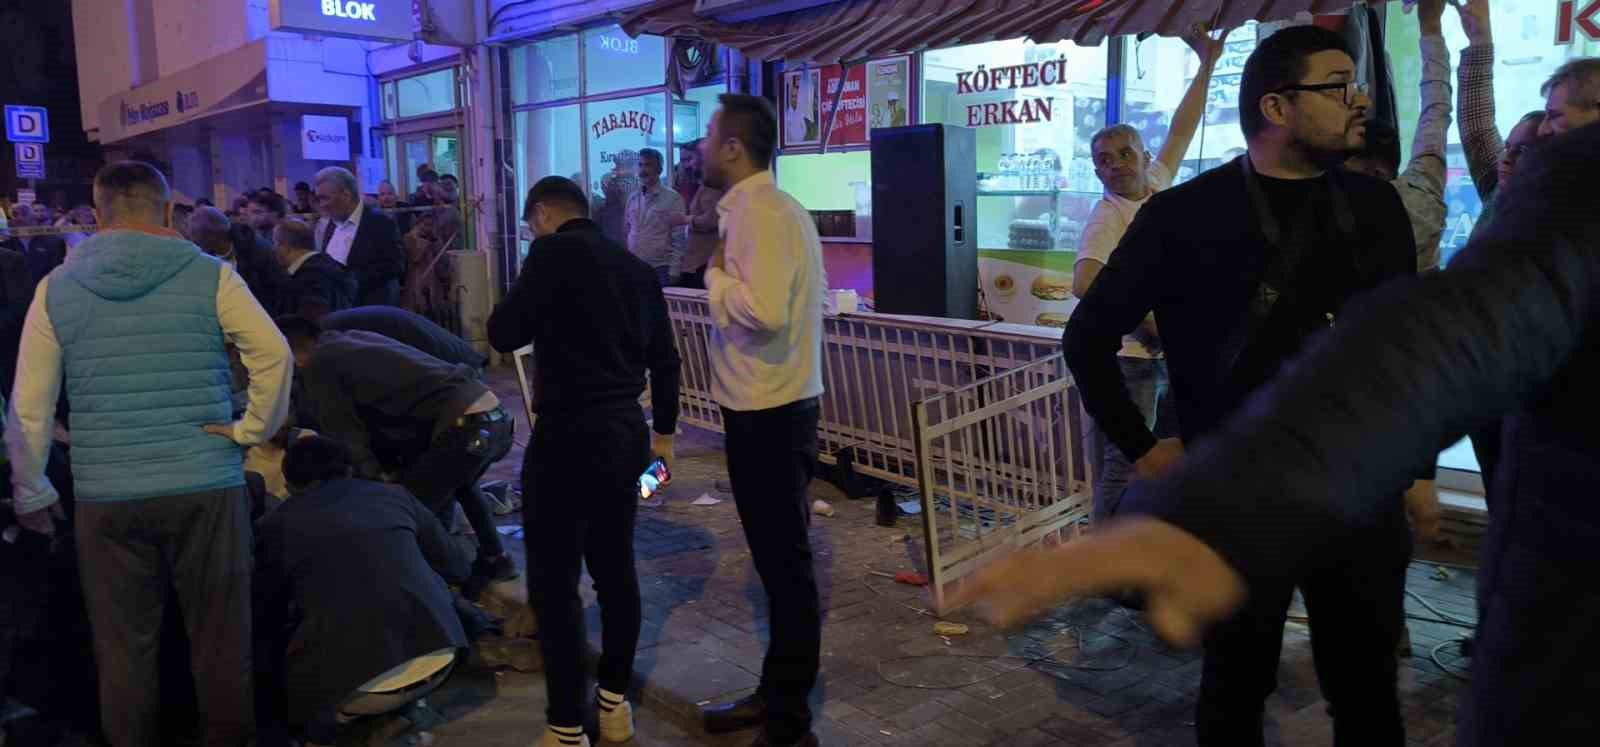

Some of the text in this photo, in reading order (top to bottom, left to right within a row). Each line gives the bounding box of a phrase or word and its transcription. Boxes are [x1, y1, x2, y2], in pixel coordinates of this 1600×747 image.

[321, 0, 376, 20] BLOK
[956, 53, 1067, 94] KÖFTECİ
[18, 114, 35, 133] D
[966, 96, 1054, 127] ERKAN
[592, 110, 656, 139] TARAKÇI
[23, 146, 36, 160] D
